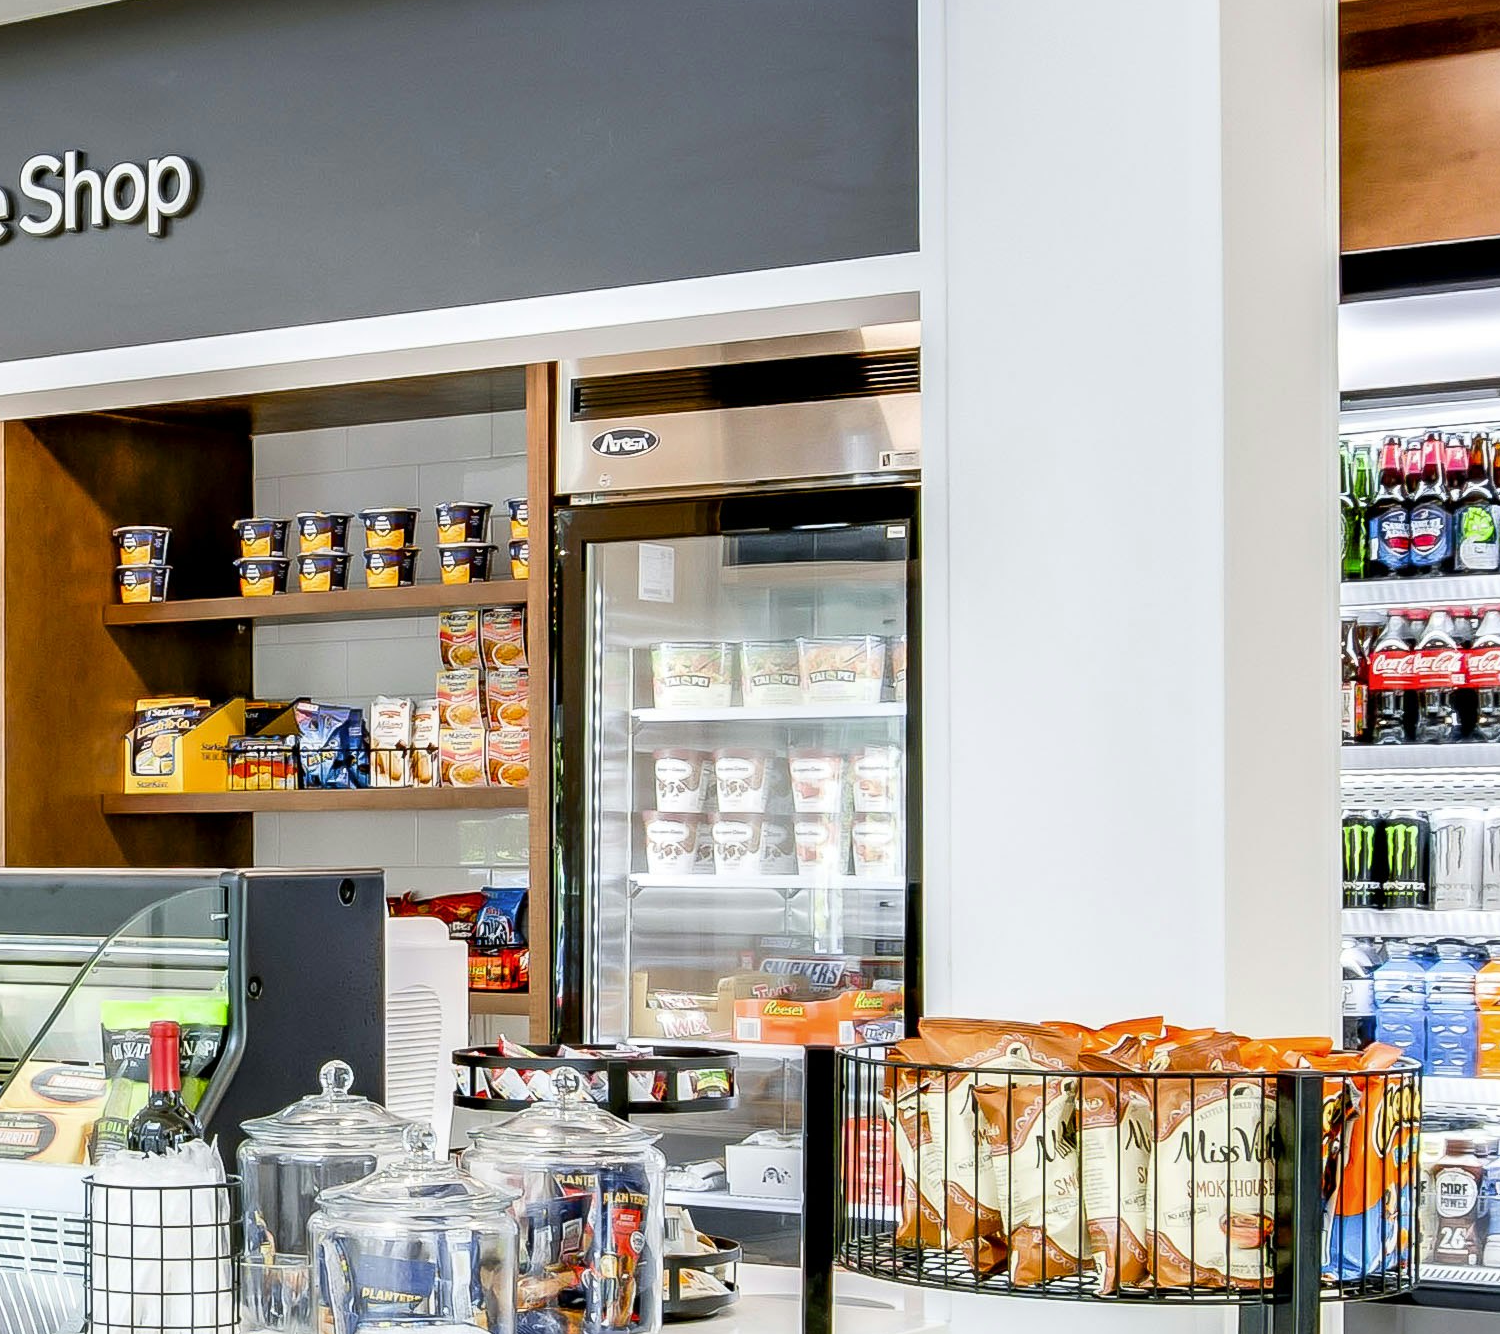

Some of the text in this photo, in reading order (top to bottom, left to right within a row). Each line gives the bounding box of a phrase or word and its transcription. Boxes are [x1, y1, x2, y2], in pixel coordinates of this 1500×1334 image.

[19, 150, 195, 238] Shop
[555, 1173, 596, 1186] PLANTE
[1186, 1178, 1276, 1199] SMOKHOUSE
